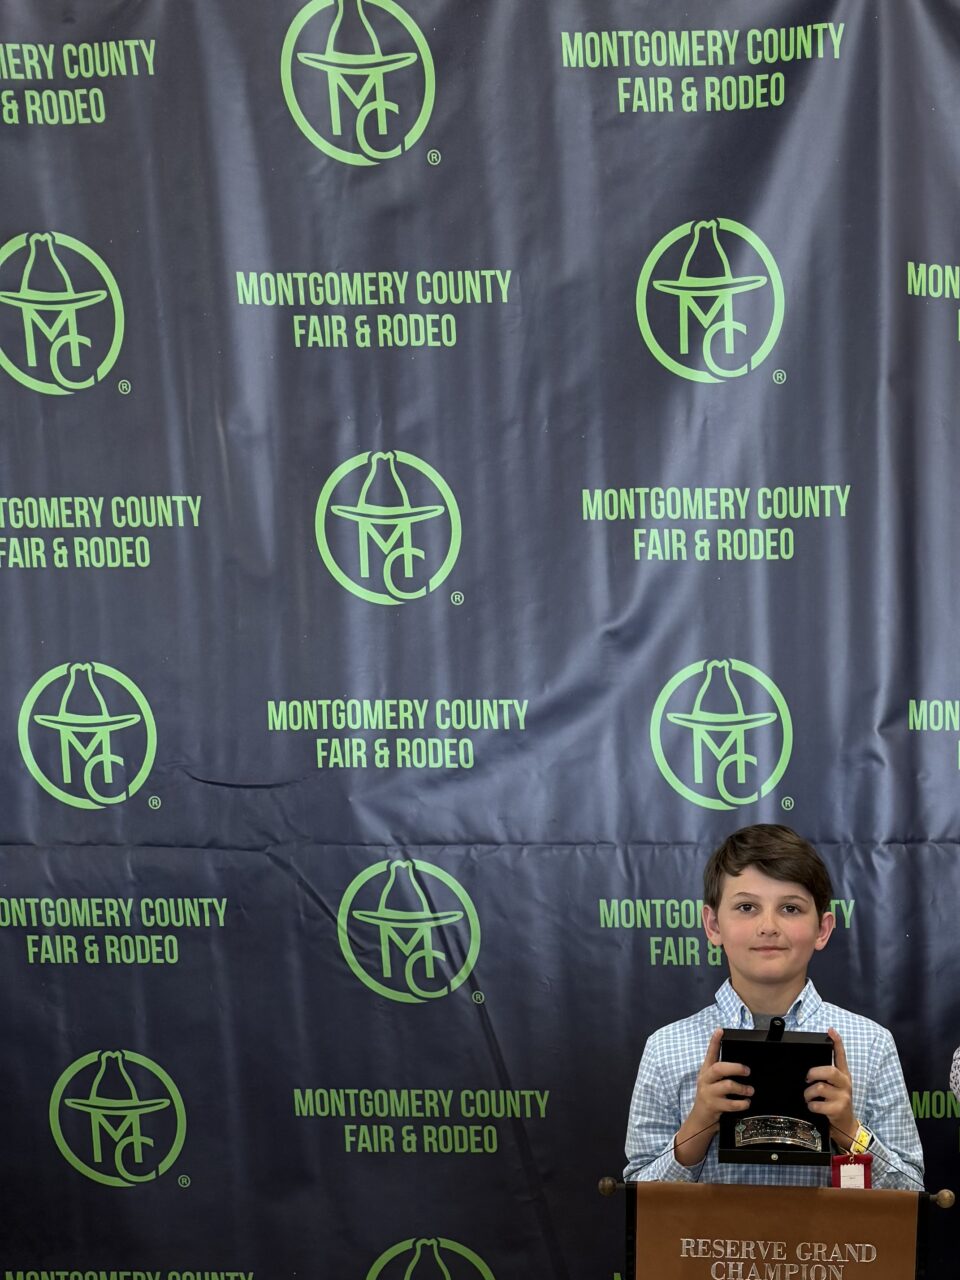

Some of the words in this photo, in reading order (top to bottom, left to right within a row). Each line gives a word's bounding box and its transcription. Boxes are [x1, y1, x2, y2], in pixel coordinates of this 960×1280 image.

[63, 39, 156, 80] COUNTY
[562, 29, 738, 68] MONTGOMERY
[747, 22, 844, 64] COUNTY
[1, 90, 19, 125] &
[25, 87, 106, 125] RODEO
[618, 77, 672, 113] FAIR
[681, 76, 697, 113] &
[705, 71, 785, 112] RODEO
[236, 271, 408, 306] MONTGOMERY
[416, 270, 511, 304] COUNTY
[293, 314, 348, 348] FAIR
[355, 315, 371, 348] &
[377, 313, 457, 348] RODEO
[111, 495, 201, 528] COUNTY
[582, 487, 749, 521] MONTGOMERY
[757, 485, 850, 520] COUNTY
[53, 536, 68, 569] &
[74, 535, 150, 568] RODEO
[633, 528, 688, 562] FAIR
[694, 529, 710, 561] &
[717, 528, 795, 561] RODEO
[267, 700, 428, 732] MONTGOMERY
[435, 699, 528, 731] COUNTY
[316, 737, 367, 769] FAIR
[373, 738, 390, 769] &
[396, 737, 474, 769] RODEO
[140, 897, 228, 928] COUNTY
[26, 935, 78, 964] FAIR
[84, 935, 99, 964] &
[104, 934, 178, 964] RODEO
[650, 936, 700, 966] FAIR
[293, 1088, 452, 1118] MONTGOMERY
[458, 1088, 550, 1119] COUNTY
[344, 1124, 394, 1153] FAIR
[401, 1125, 417, 1153] &
[422, 1124, 498, 1153] RODEO
[680, 1238, 787, 1261] RESERVE
[796, 1242, 877, 1263] GRAND
